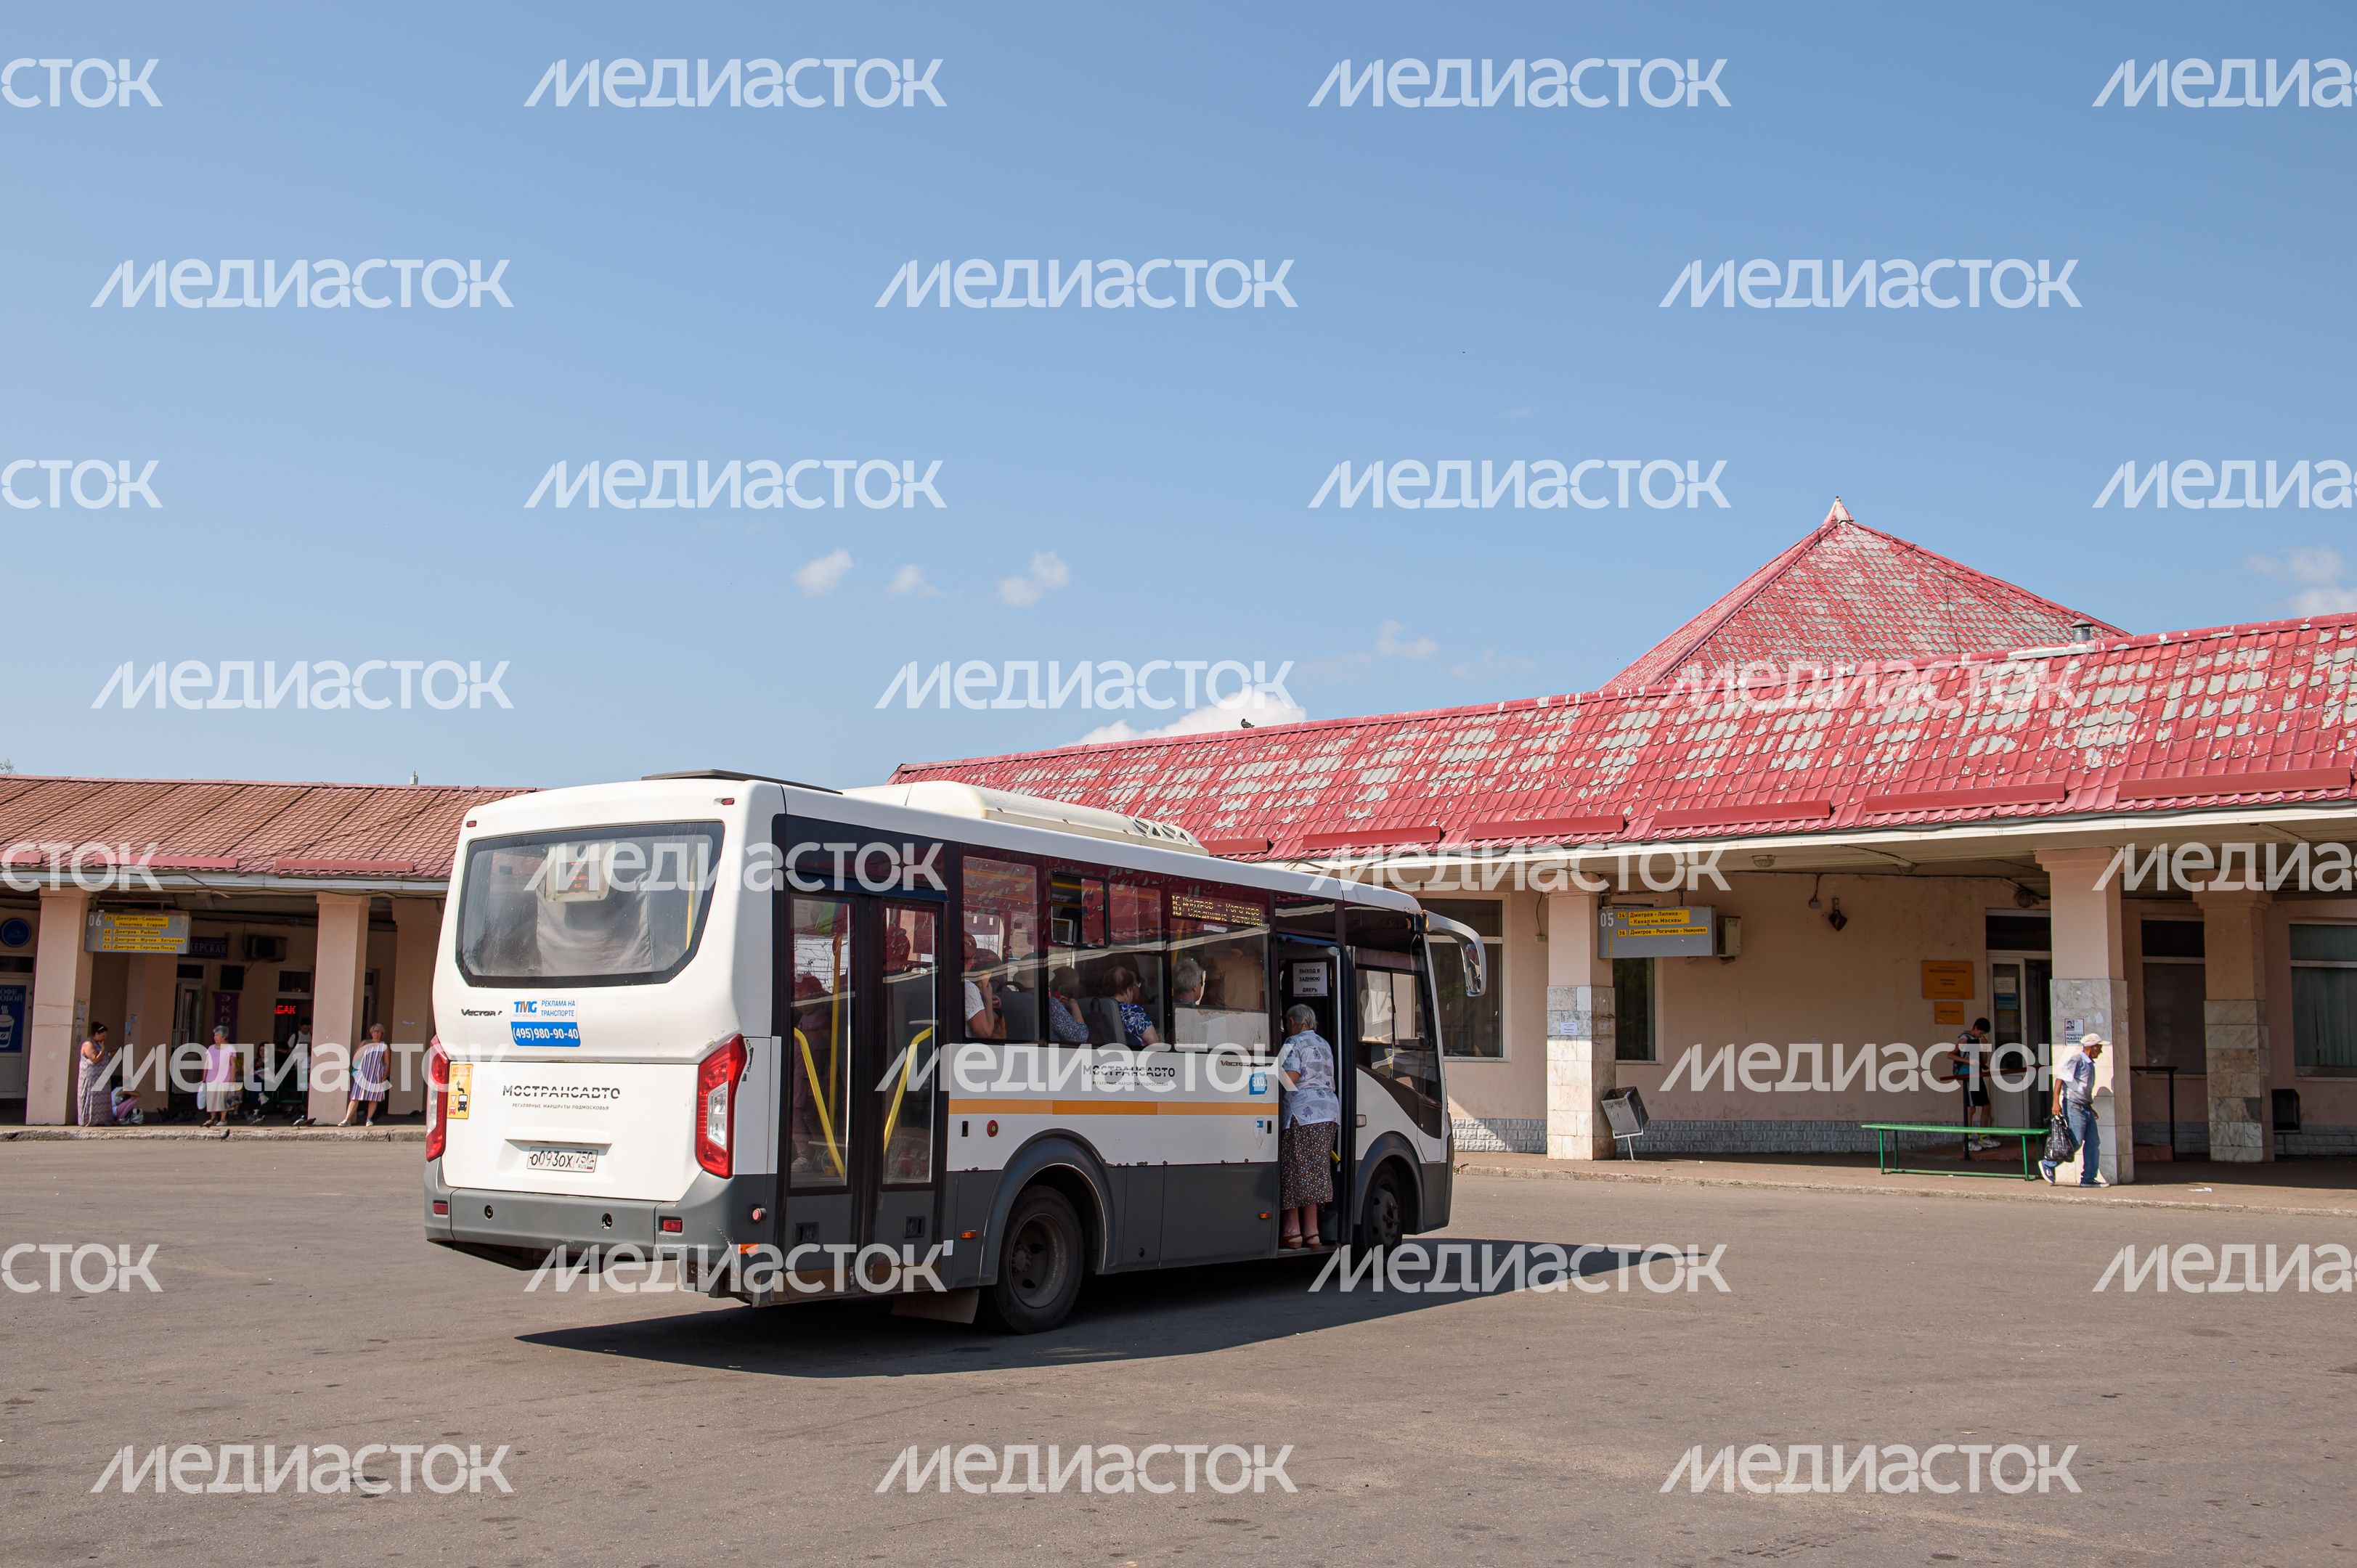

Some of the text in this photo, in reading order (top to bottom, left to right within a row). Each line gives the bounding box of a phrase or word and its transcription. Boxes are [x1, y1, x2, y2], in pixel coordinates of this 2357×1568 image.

[89, 915, 101, 926] 06
[1600, 912, 1613, 926] 05
[0, 993, 23, 1002] ОБОЙ
[221, 995, 231, 1024] ЭКО
[274, 1005, 296, 1015] БАК
[1083, 1065, 1175, 1077] МОСТРАНСАВТО
[502, 1085, 620, 1099] МОСТРАНСАВТО
